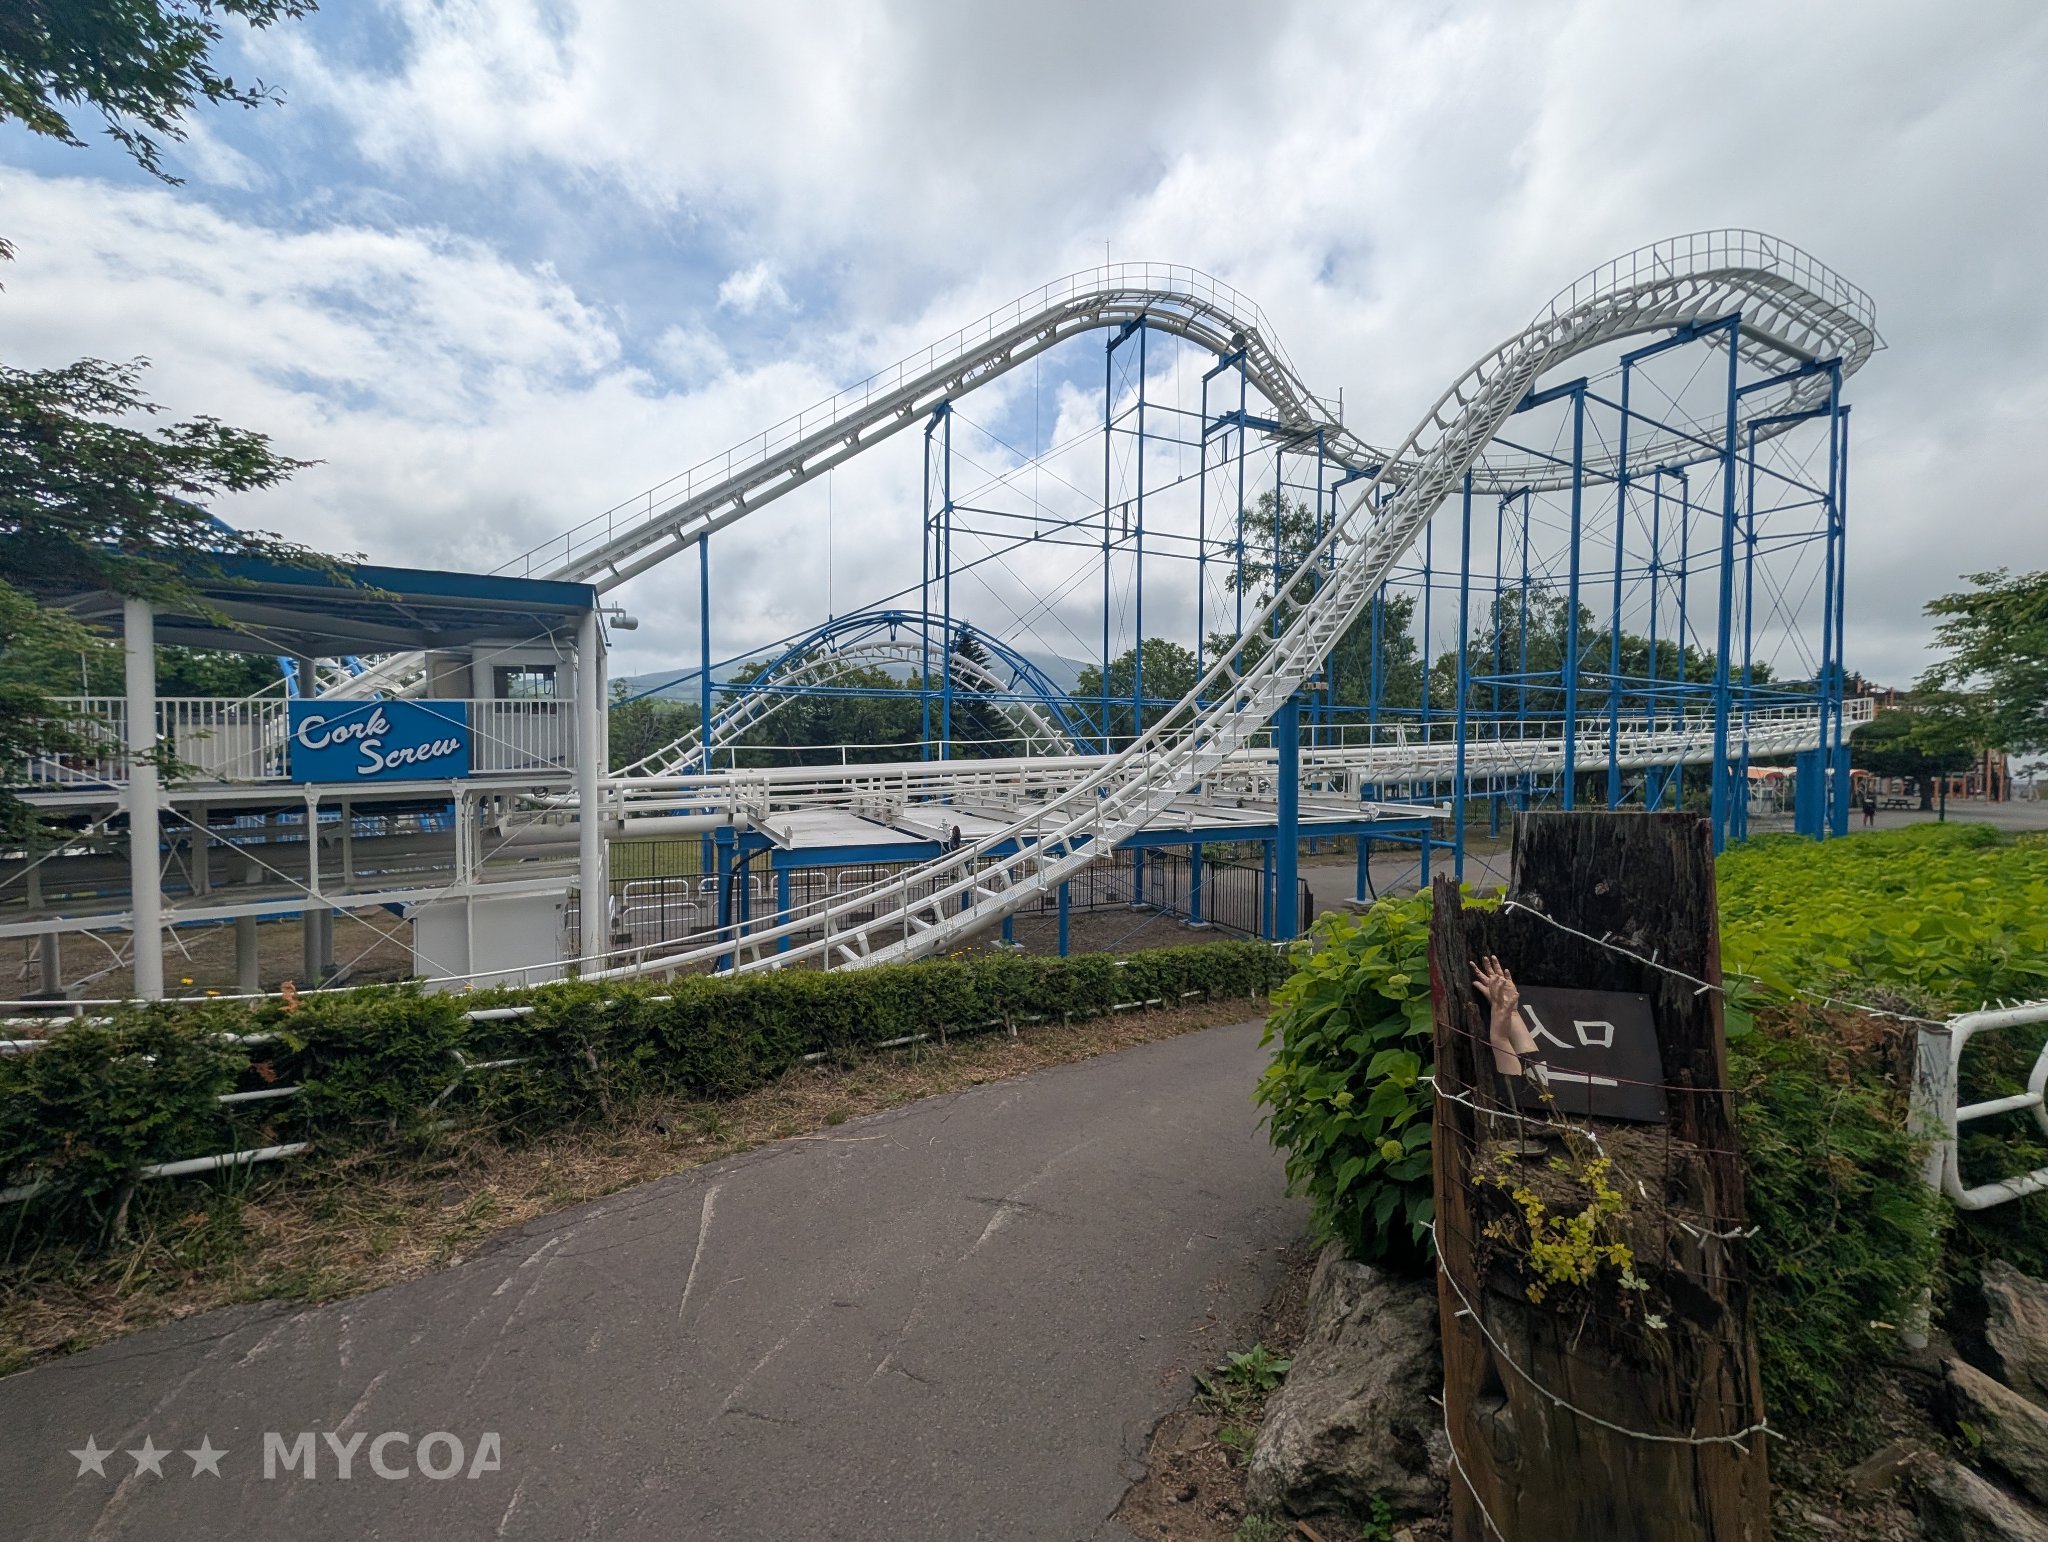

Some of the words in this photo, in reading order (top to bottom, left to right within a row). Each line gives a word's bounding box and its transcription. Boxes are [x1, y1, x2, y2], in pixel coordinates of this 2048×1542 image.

[297, 707, 390, 749] Cork
[357, 738, 460, 774] Screw
[1520, 1004, 1615, 1049] 入口
